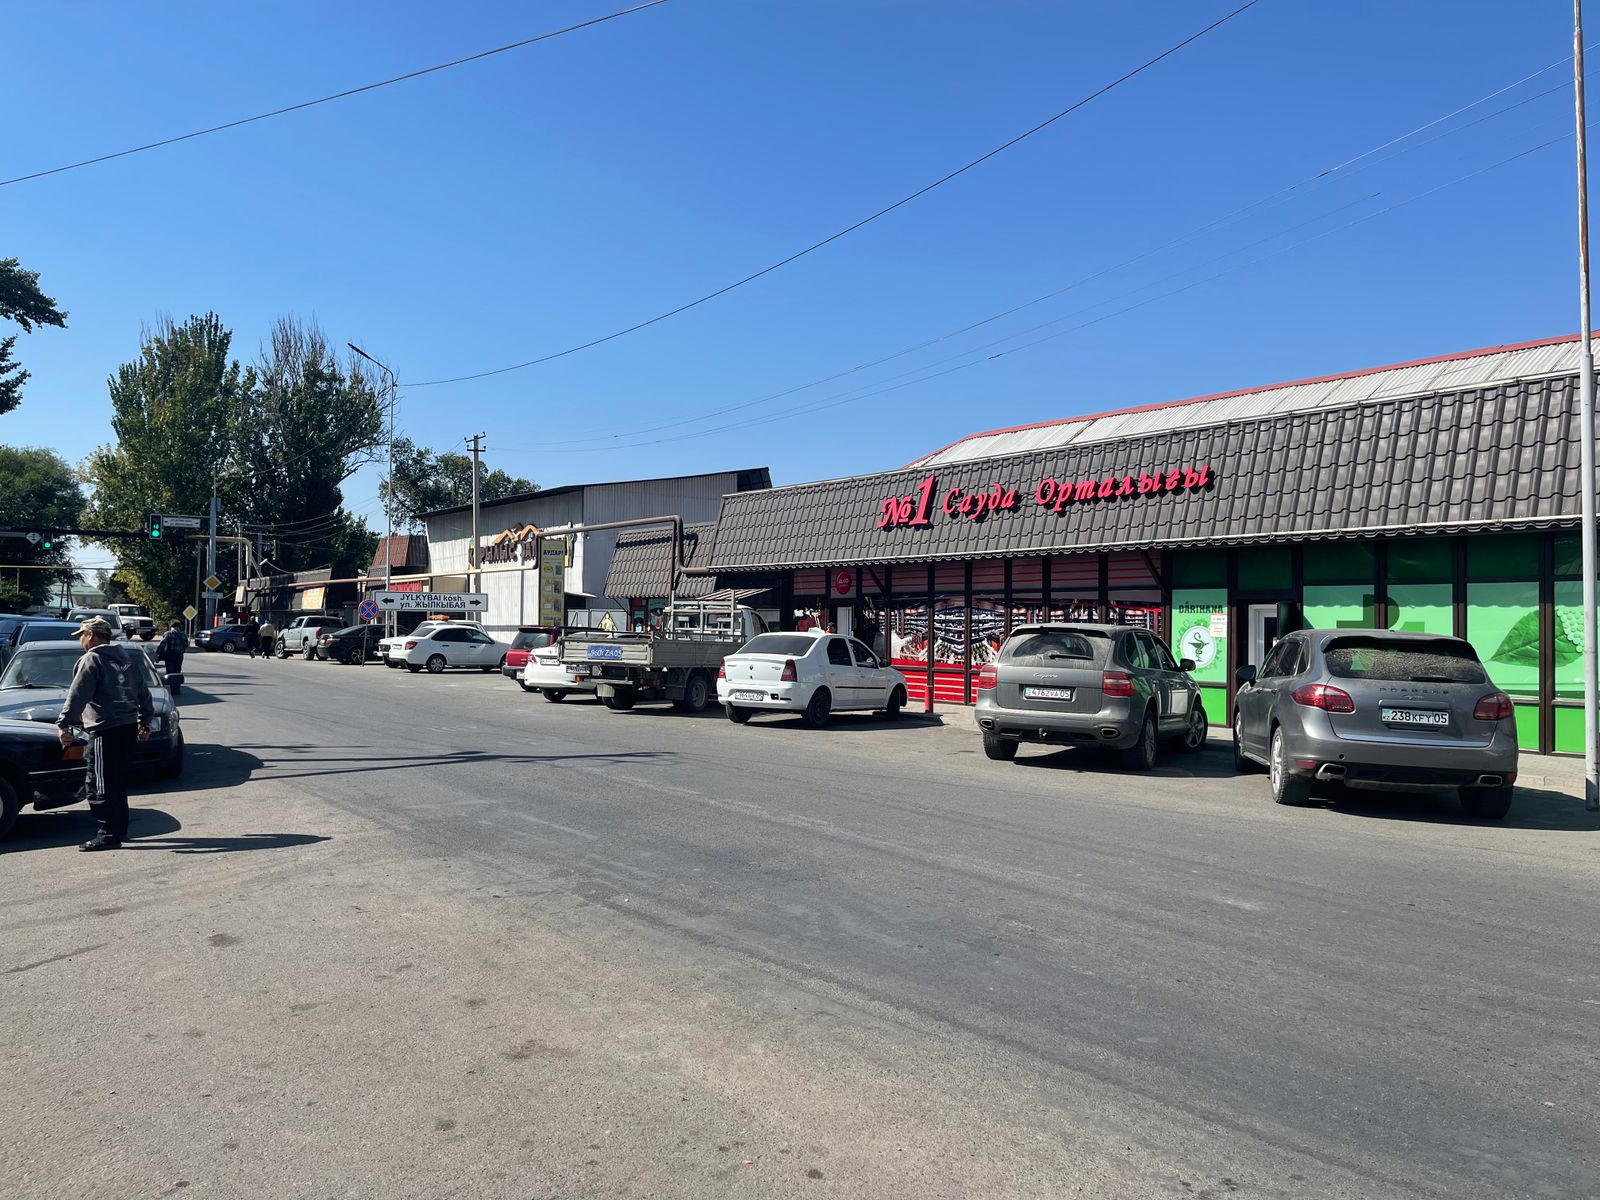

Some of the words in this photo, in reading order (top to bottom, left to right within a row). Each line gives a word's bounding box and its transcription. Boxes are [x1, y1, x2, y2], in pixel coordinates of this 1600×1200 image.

[942, 482, 1017, 520] Сауда
[400, 593, 441, 601] JYLKYBAI
[414, 601, 466, 609] ЖЫЛКЫБАЯ
[1178, 600, 1223, 613] DÁRIHANA
